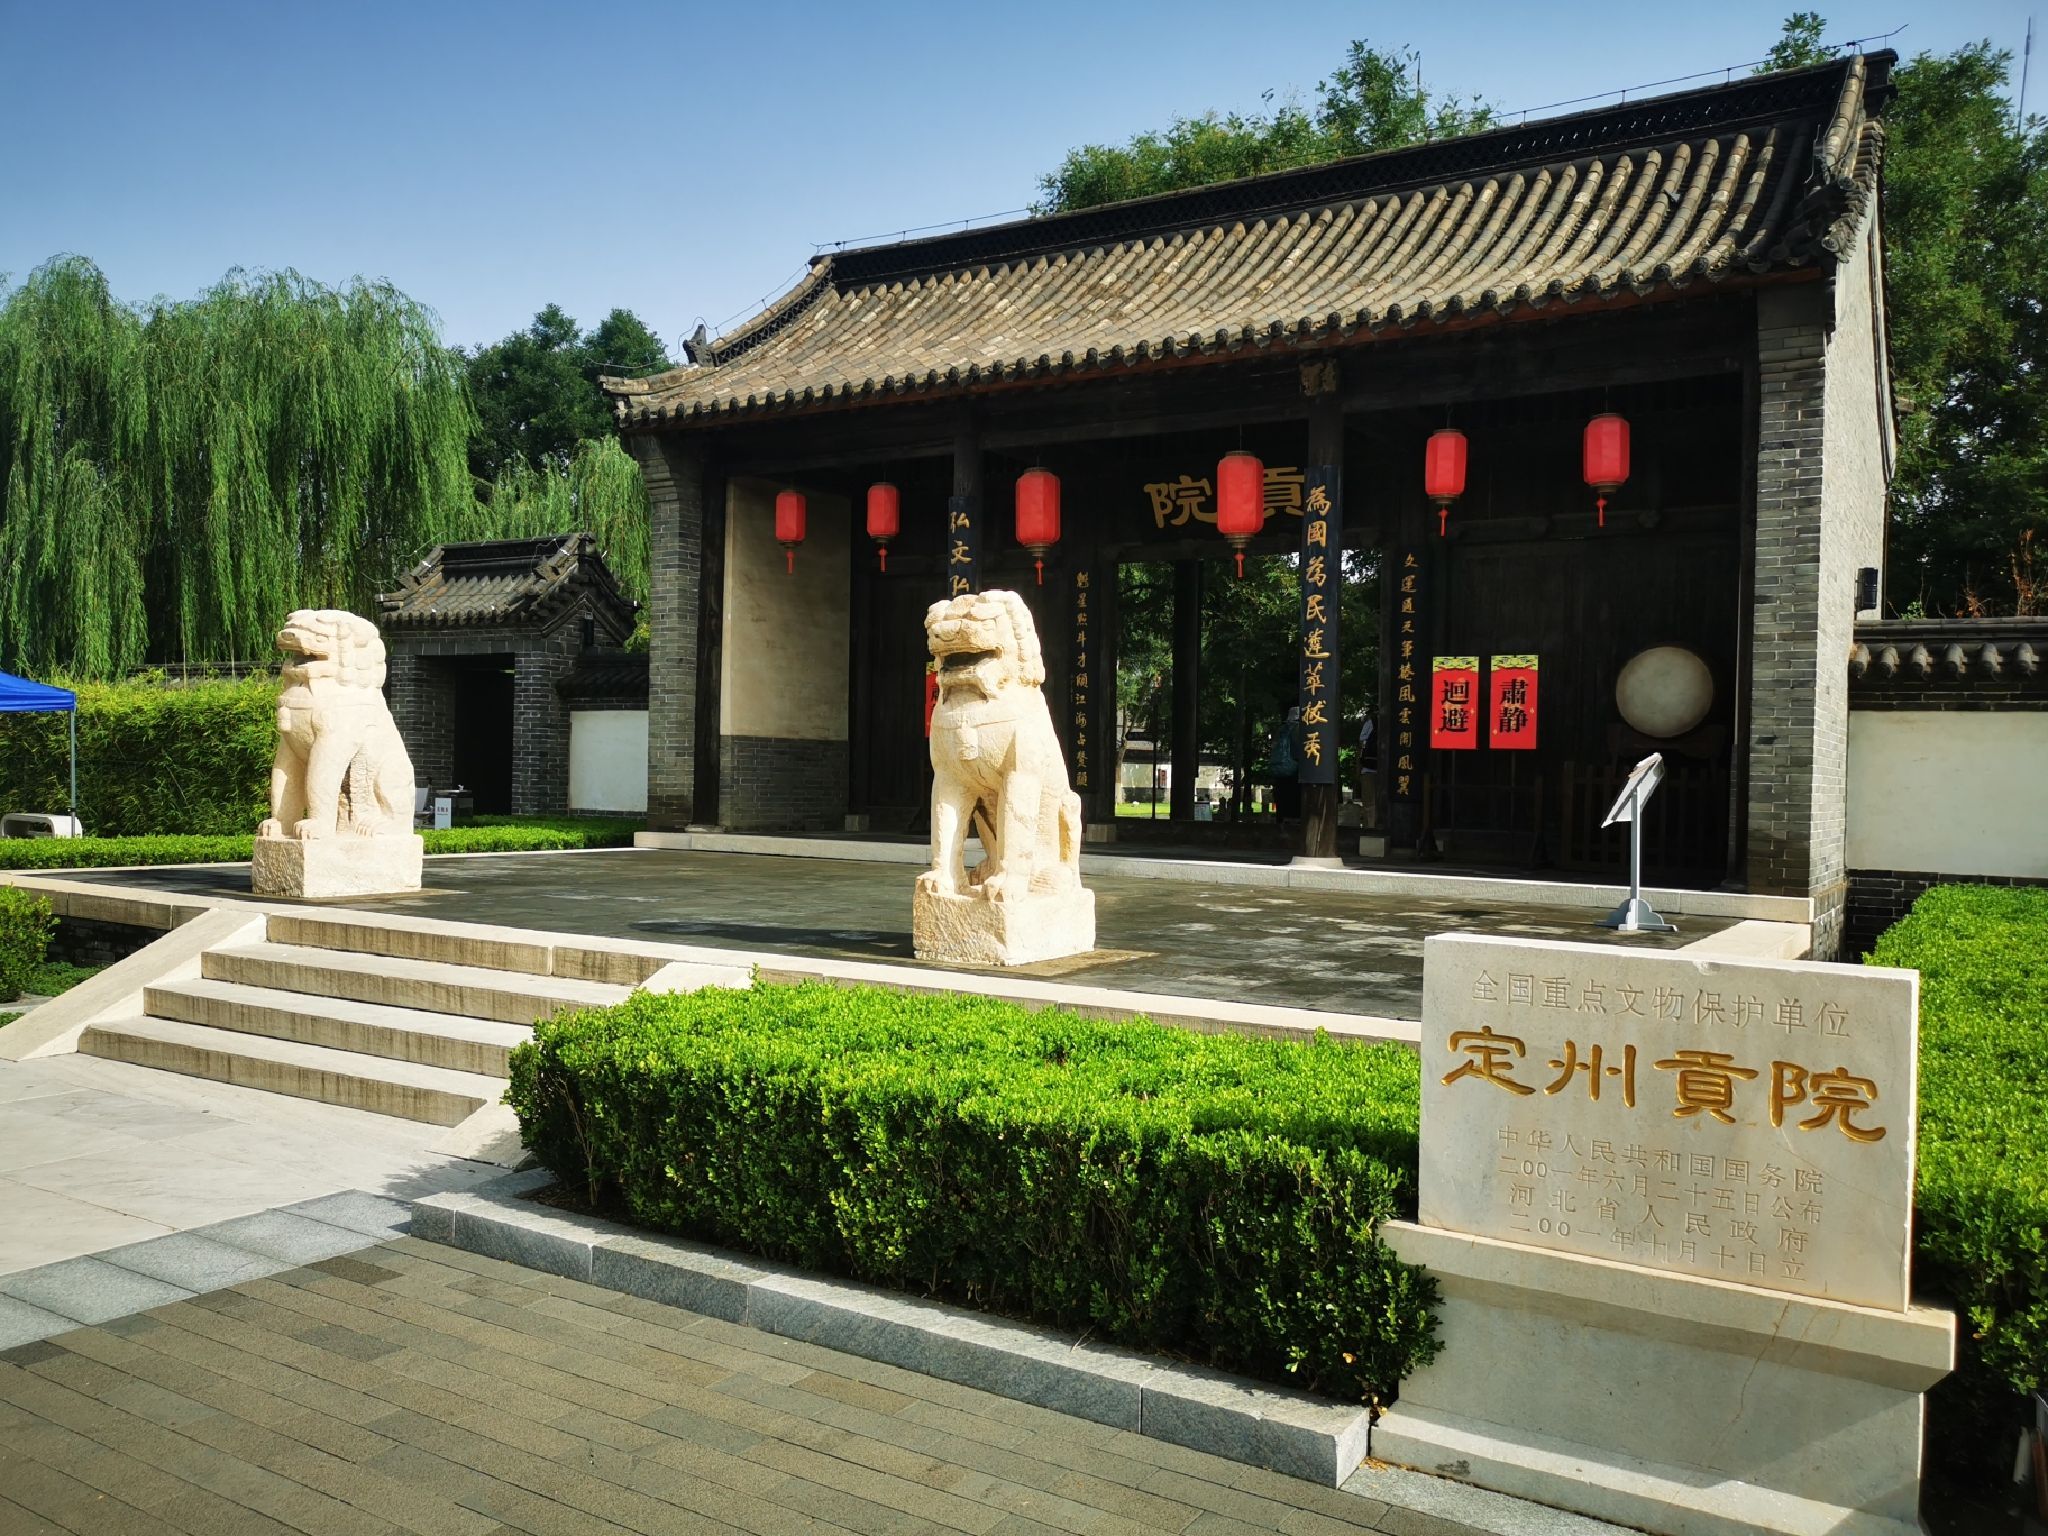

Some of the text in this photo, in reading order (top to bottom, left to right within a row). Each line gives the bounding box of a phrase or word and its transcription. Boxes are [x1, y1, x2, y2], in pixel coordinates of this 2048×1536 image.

[1471, 969, 1850, 1039] 全国重点文物保护单位
[1440, 1025, 1887, 1144] 定州貢院
[1497, 1125, 1824, 1195] 中华人民共和国国务院
[1509, 1183, 1808, 1253] 河北省人民政府
